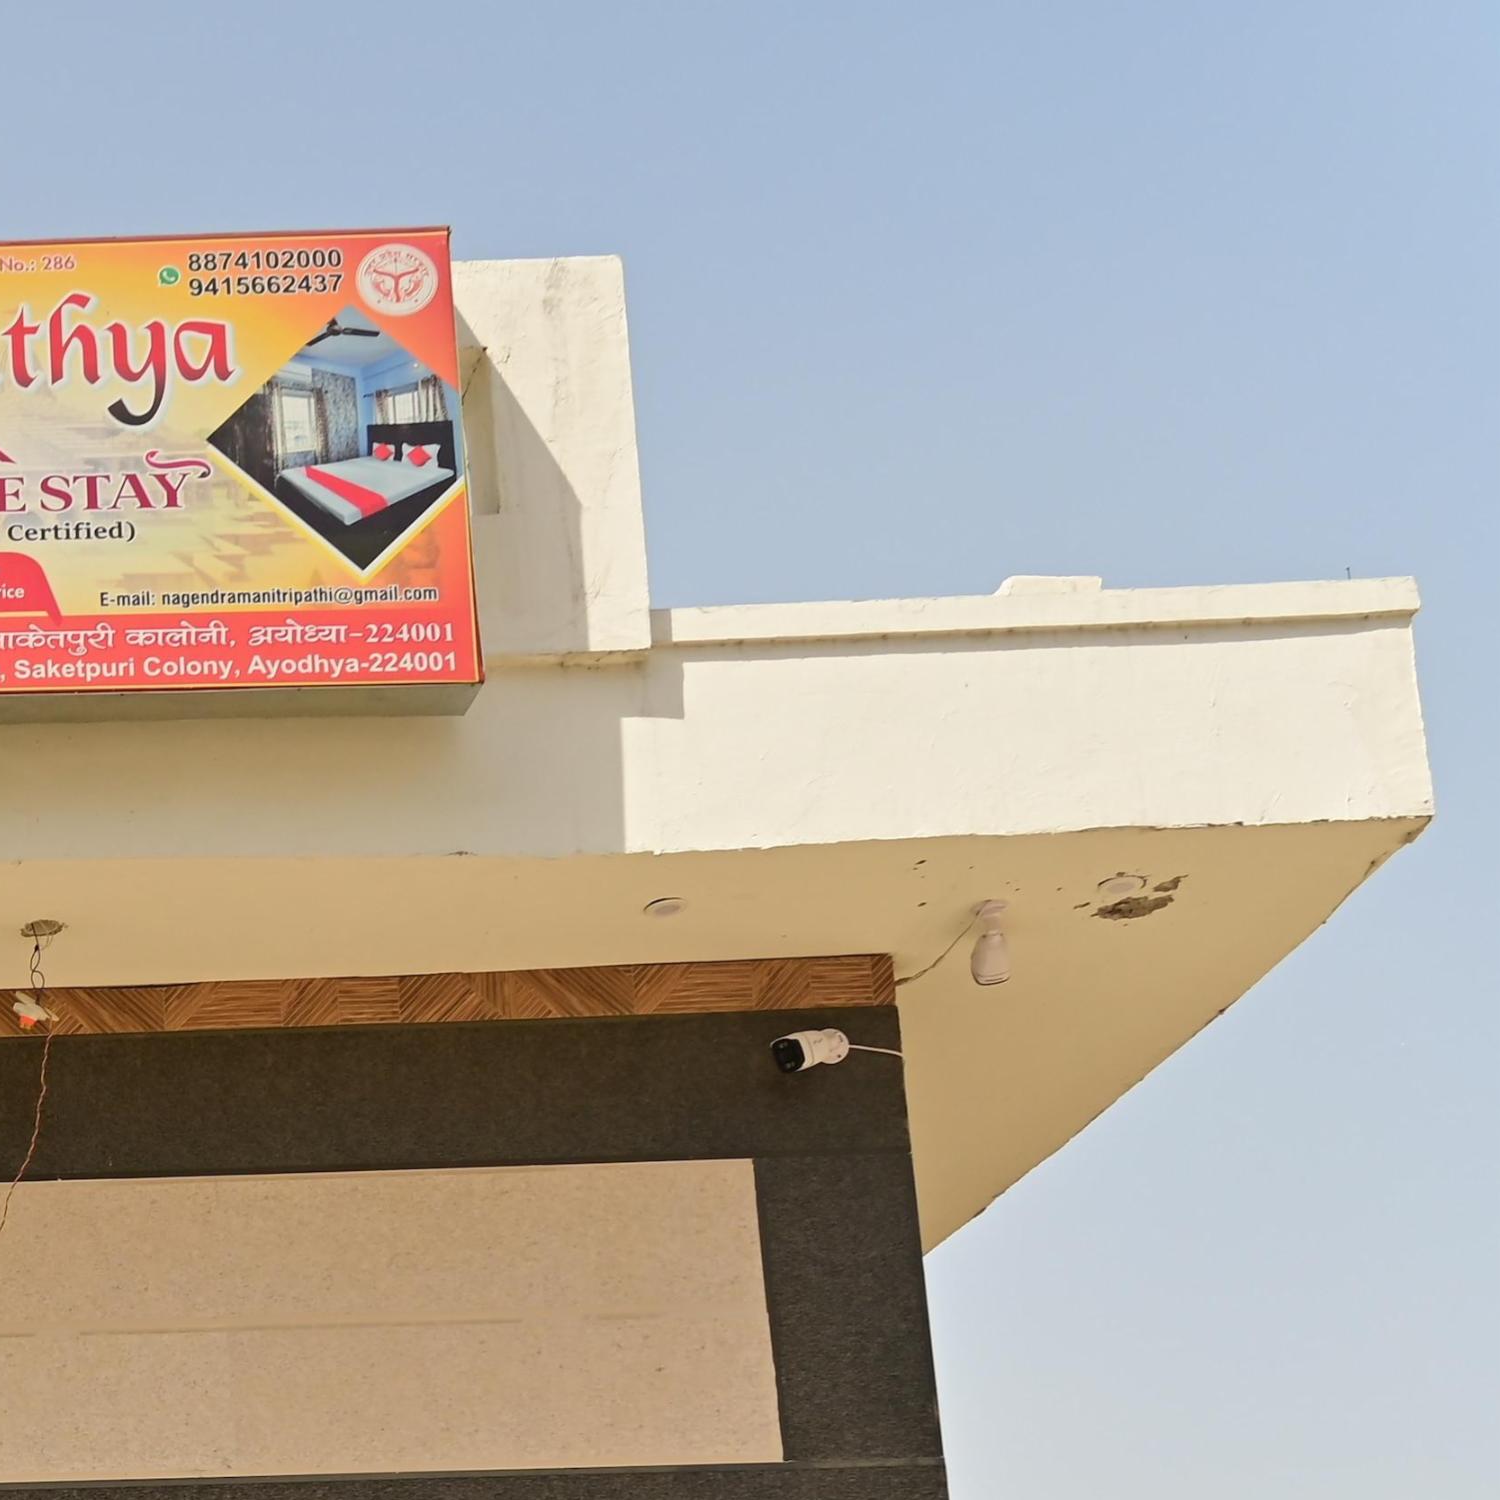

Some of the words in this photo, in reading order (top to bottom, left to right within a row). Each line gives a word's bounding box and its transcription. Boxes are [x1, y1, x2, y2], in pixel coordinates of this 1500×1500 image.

[0, 257, 35, 271] No.:
[42, 255, 75, 270] 286
[188, 249, 342, 271] 8874102000
[188, 274, 342, 296] 9415662437
[39, 472, 192, 513] STAY
[7, 520, 136, 543] Certified)
[100, 591, 155, 607] E-mail:
[161, 585, 438, 608] nagendramanitripathi@gmail.com
[125, 619, 236, 648] कालोनी,
[14, 657, 135, 682] Saketpuri
[143, 656, 240, 680] Colony,
[247, 651, 456, 680] Ayodhya-224001
